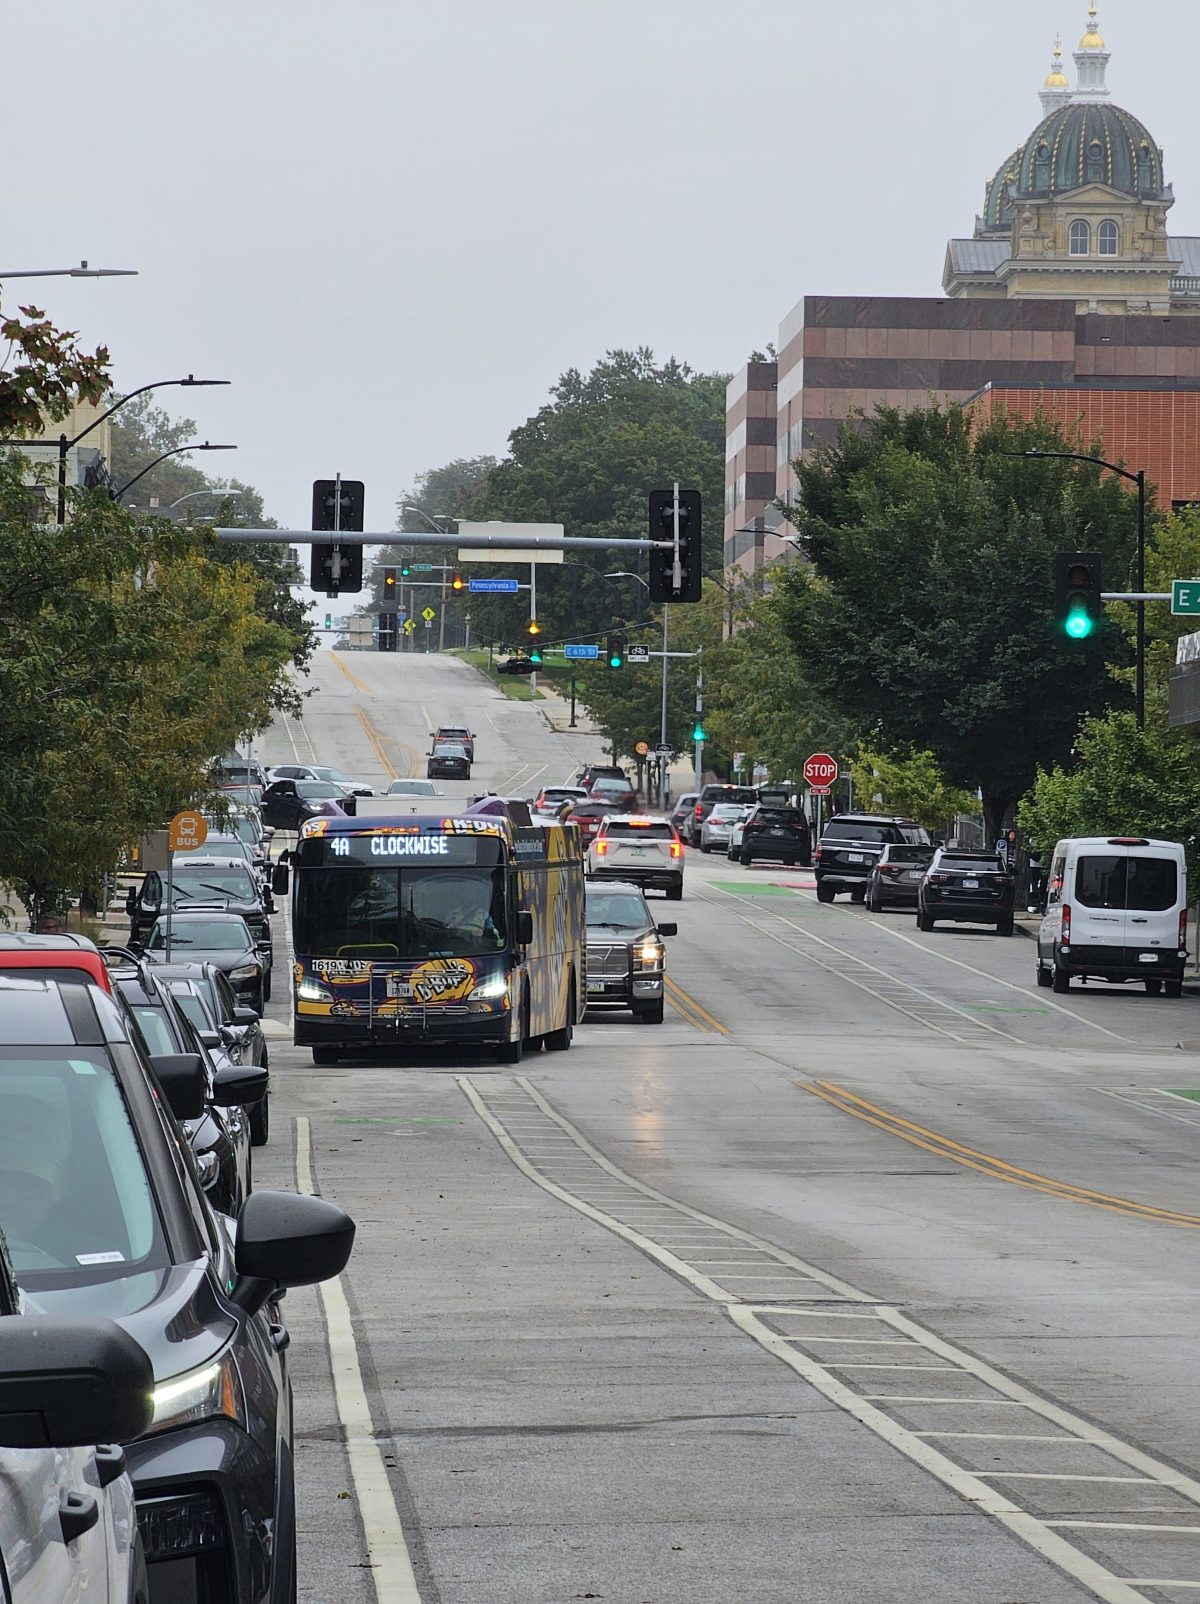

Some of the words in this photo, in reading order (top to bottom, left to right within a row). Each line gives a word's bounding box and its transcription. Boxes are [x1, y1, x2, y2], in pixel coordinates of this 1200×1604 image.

[471, 581, 509, 590] Pennsylvania
[1179, 589, 1190, 606] E
[805, 763, 835, 777] STOP
[176, 837, 199, 846] BUS
[330, 837, 350, 856] 4A
[370, 835, 448, 856] CLOCKWISE
[312, 960, 337, 971] 1619
